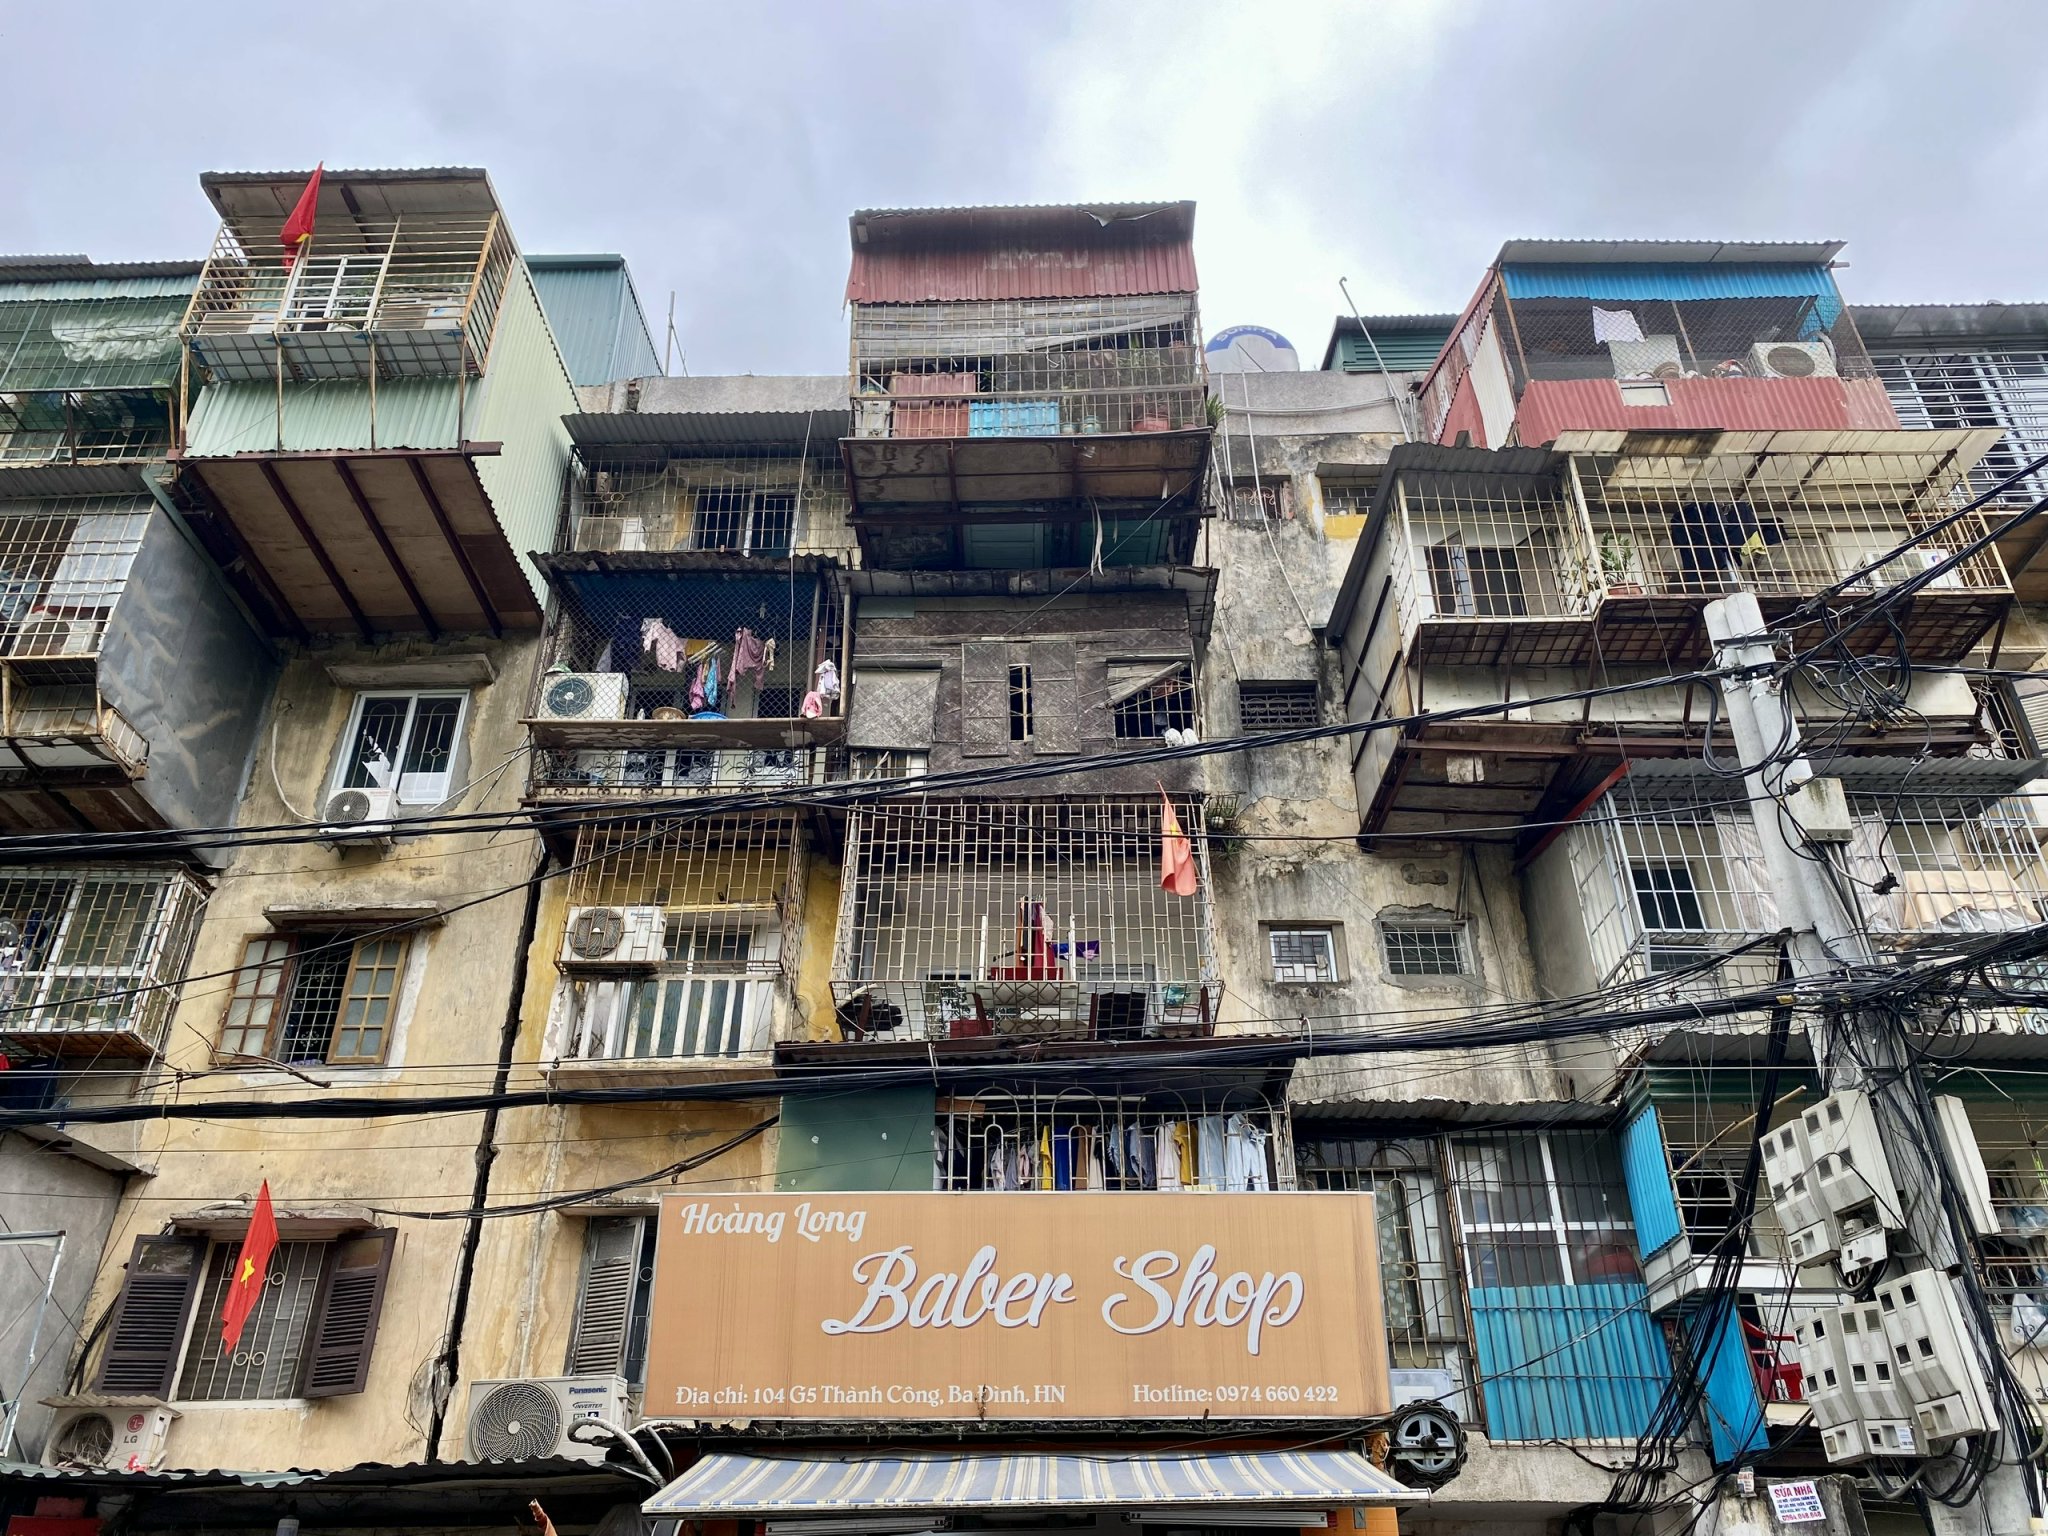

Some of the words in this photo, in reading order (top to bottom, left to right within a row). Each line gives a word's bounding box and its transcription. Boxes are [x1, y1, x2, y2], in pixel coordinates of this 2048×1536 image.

[681, 1203, 786, 1243] Hoàng
[794, 1202, 867, 1243] Long
[821, 1245, 1077, 1335] Baber
[1102, 1244, 1305, 1355] Shop
[569, 1386, 607, 1394] Panasonic
[676, 1387, 710, 1408] Địa
[714, 1384, 748, 1404] chỉ:
[753, 1388, 784, 1404] 104
[789, 1386, 817, 1404] G5
[821, 1386, 883, 1404] Thành
[887, 1386, 944, 1407] Công,
[948, 1386, 974, 1403] Ba
[1033, 1385, 1066, 1403] HN
[1133, 1384, 1213, 1403] Hotline:
[1216, 1386, 1262, 1402] 0974
[1265, 1386, 1300, 1402] 660
[1304, 1386, 1338, 1402] 422
[123, 1435, 138, 1444] LG
[1774, 1486, 1793, 1498] SỬA
[1793, 1483, 1813, 1496] NHÀ
